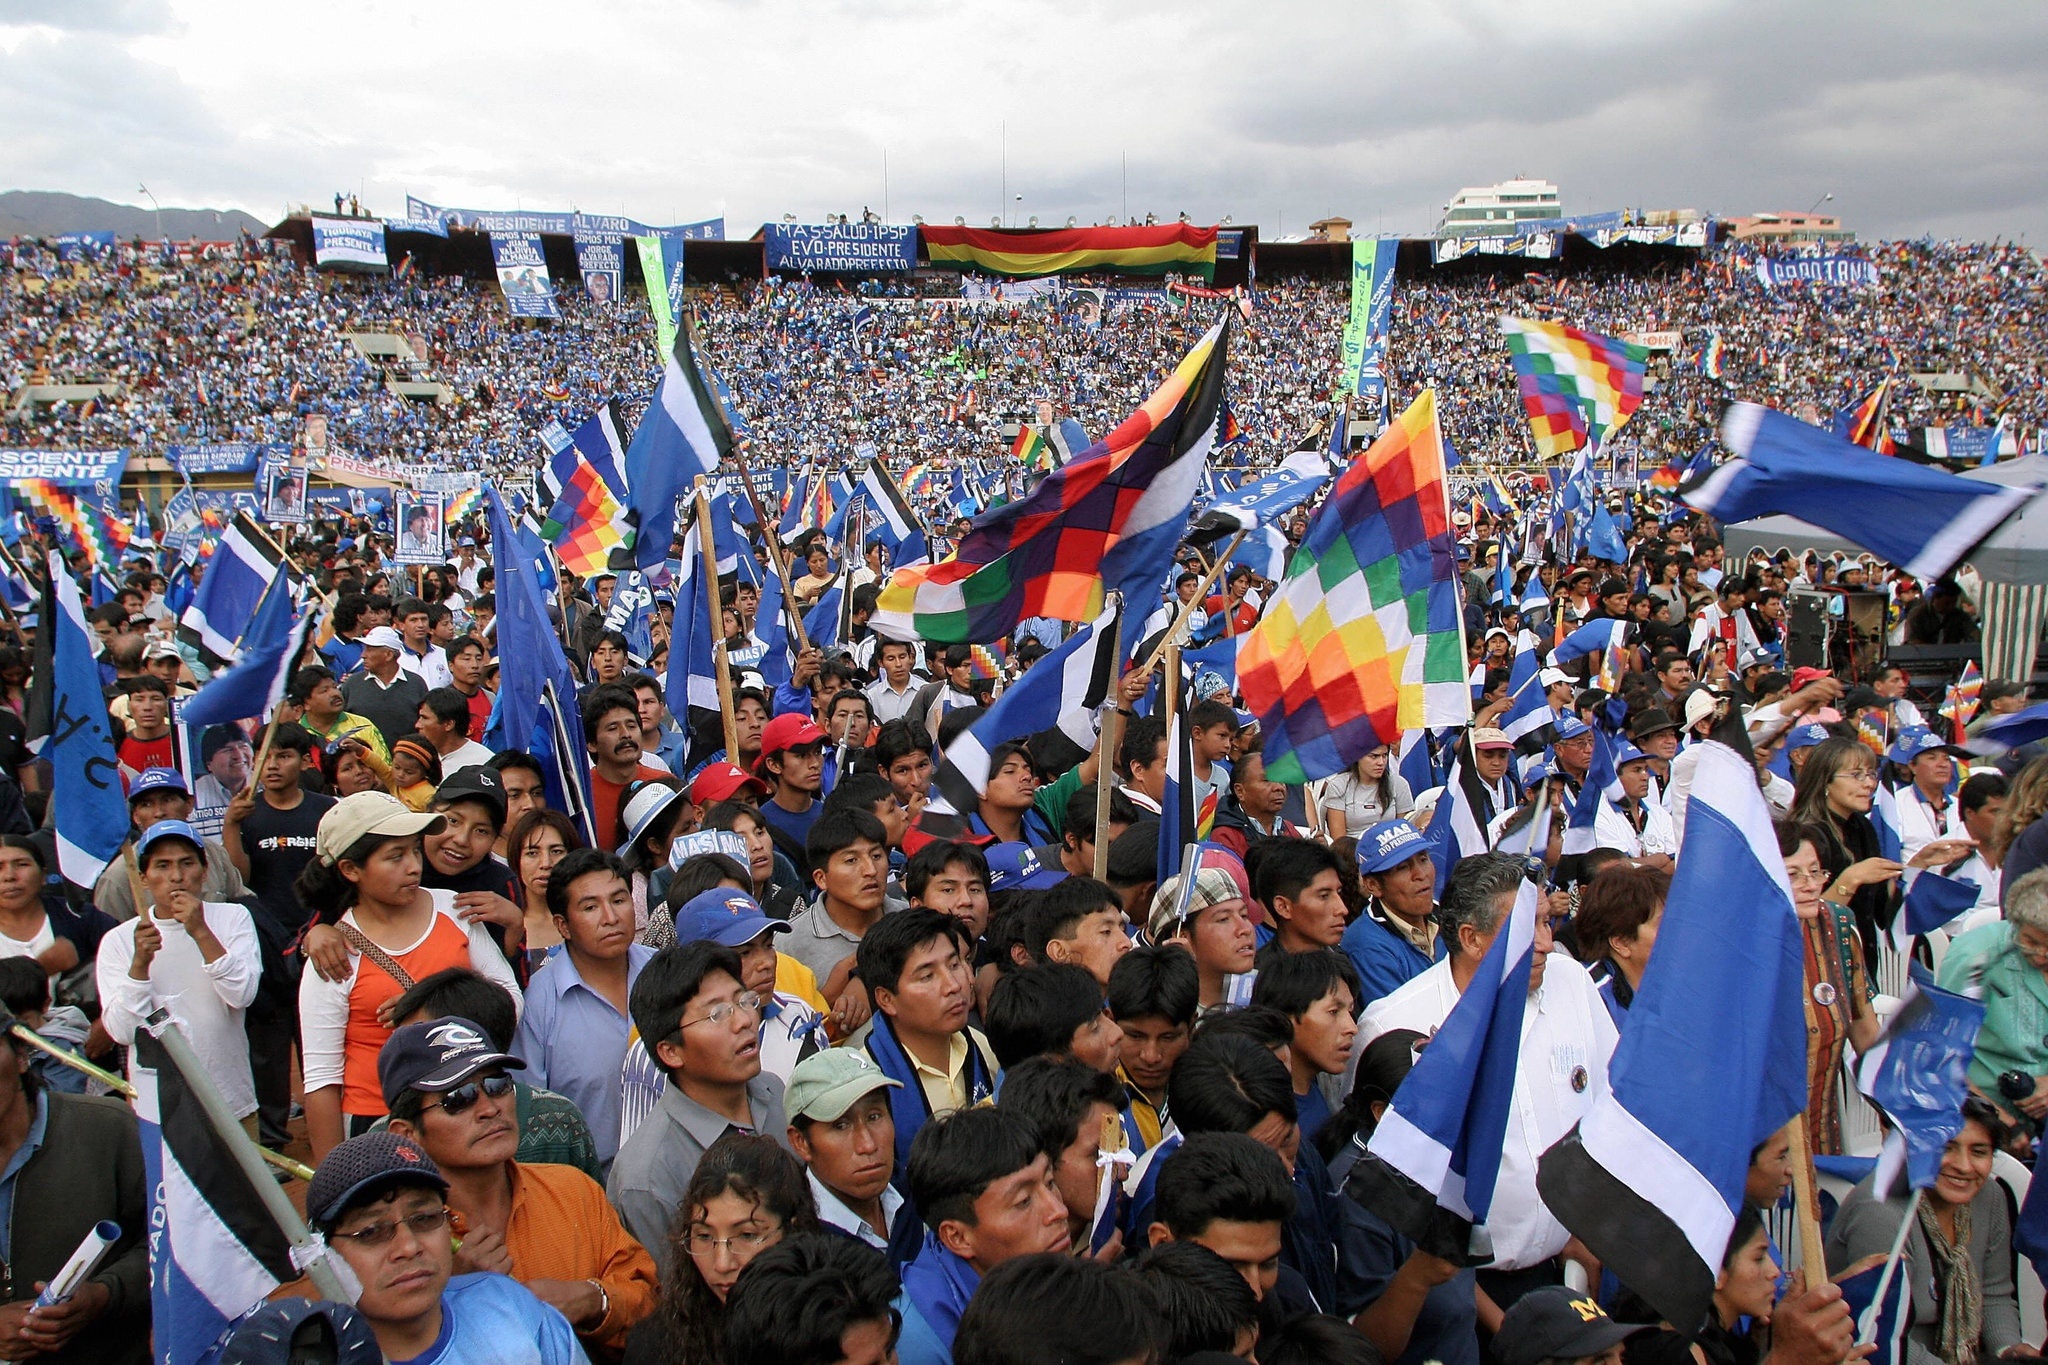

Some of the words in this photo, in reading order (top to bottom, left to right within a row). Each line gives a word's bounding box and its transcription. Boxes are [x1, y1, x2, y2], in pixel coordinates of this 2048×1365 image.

[478, 216, 566, 232] PRESIDENTE
[572, 213, 630, 231] ALVARO
[490, 232, 519, 240] SOMOS
[522, 232, 541, 240] MAS
[574, 234, 602, 243] SOMOS
[604, 235, 622, 244] MAS
[1628, 230, 1654, 245] MAS
[324, 238, 374, 252] PRESENTE
[585, 246, 612, 254] JORGE
[1480, 240, 1505, 254] MAS
[579, 253, 619, 262] ALVARADO
[1370, 267, 1395, 306] CONTIGO
[0, 450, 120, 465] SCIENTE
[0, 464, 107, 479] SIDENTE
[422, 544, 444, 555] MAS
[734, 647, 760, 663] MAS
[1376, 823, 1413, 846] MAS
[1378, 845, 1391, 857] EVO
[1568, 1296, 1608, 1323] M
